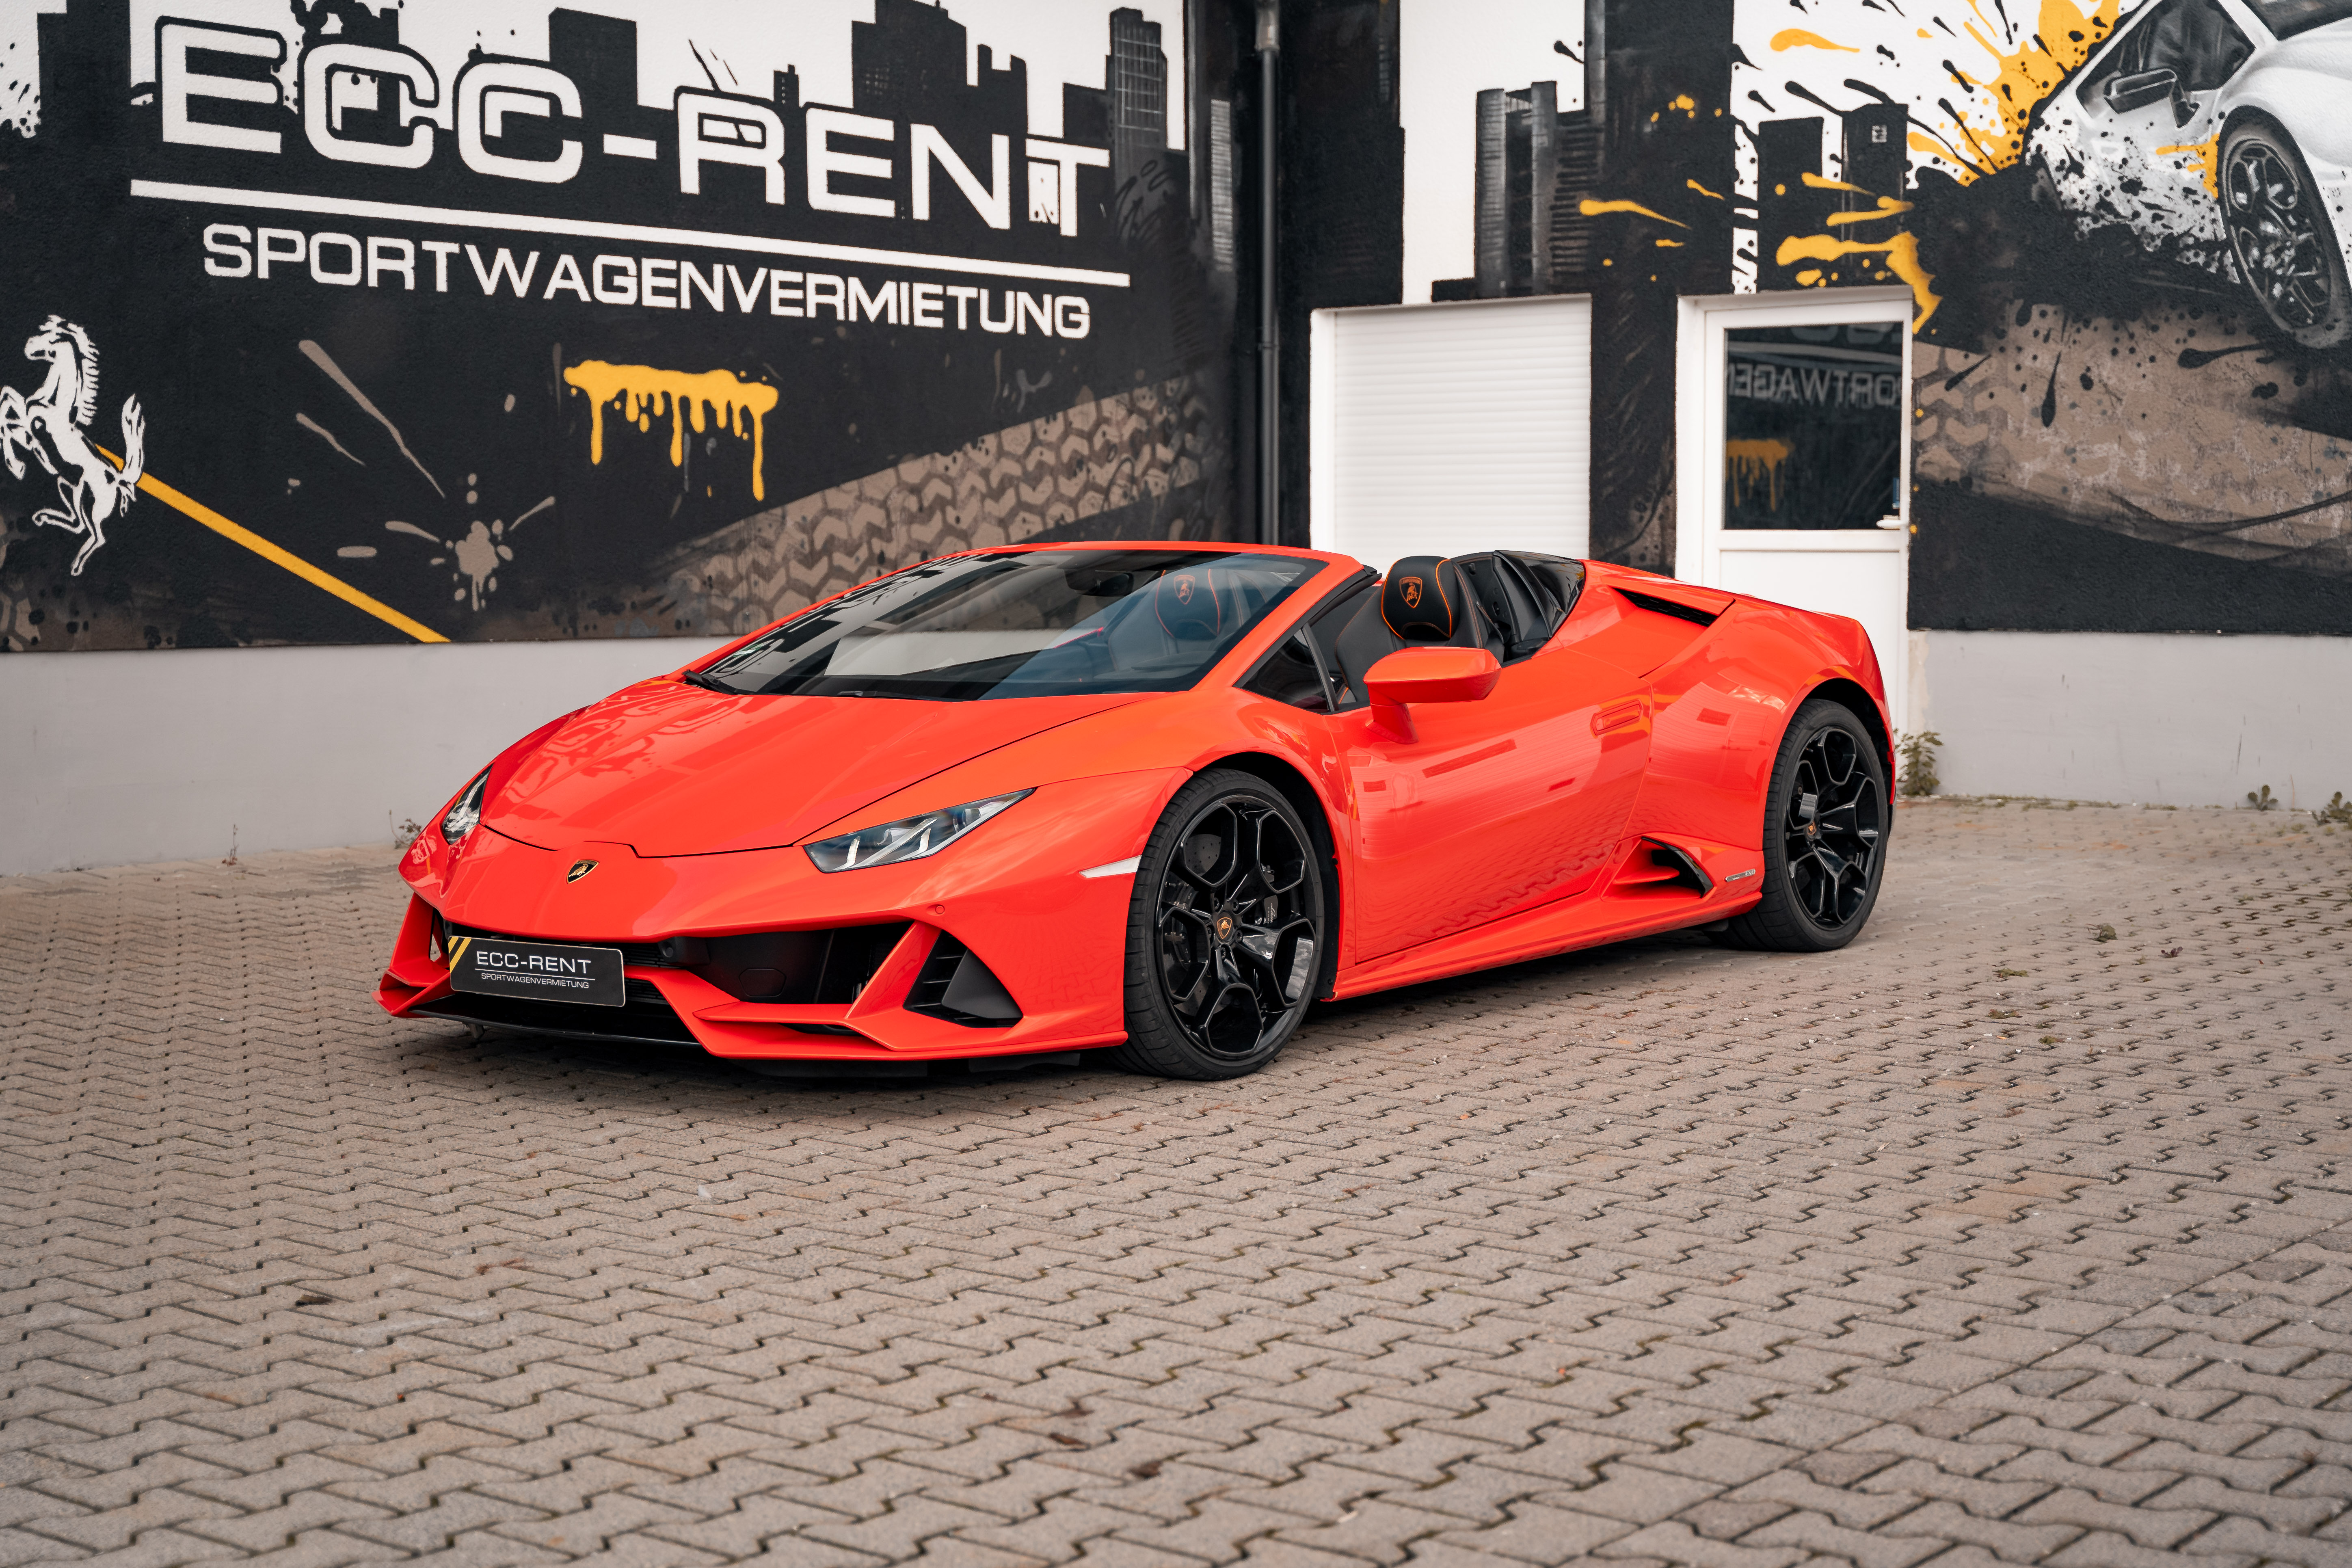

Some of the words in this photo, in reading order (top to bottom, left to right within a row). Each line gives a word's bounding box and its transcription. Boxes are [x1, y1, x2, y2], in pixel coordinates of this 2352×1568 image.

[162, 24, 1110, 237] ECC-RENT
[203, 223, 1090, 339] SPORTWAGENVERMIETUNG
[477, 951, 591, 974] ECC-RENT
[481, 973, 589, 988] SPORTWAGENVERMIETUNG
